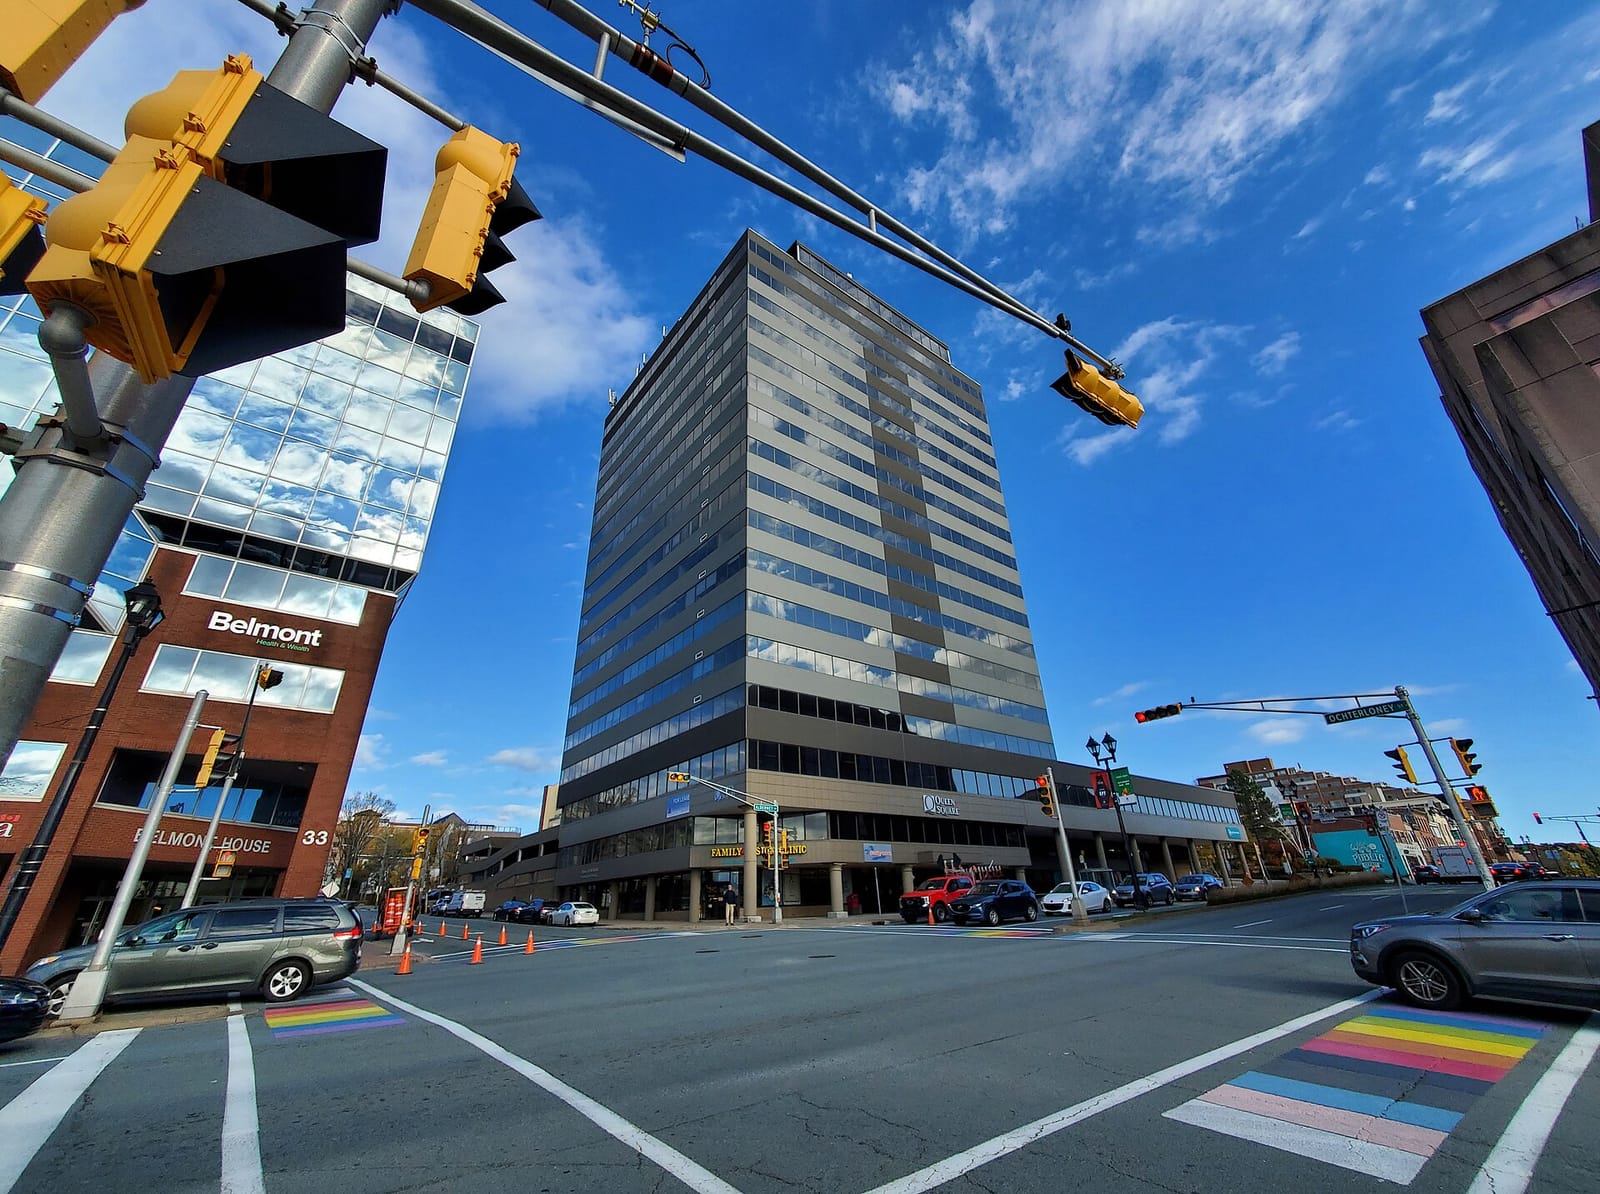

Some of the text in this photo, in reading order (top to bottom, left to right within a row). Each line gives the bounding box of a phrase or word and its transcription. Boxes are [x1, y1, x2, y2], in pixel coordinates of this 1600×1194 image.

[208, 611, 323, 647] Belmont
[256, 639, 279, 648] Health
[287, 643, 309, 652] Wealth
[1328, 703, 1394, 722] OCHTERLONEY
[133, 828, 271, 853] BLMON HOUSE
[302, 830, 328, 845] 33
[711, 847, 743, 857] FAMILY
[779, 845, 807, 854] CLINIC
